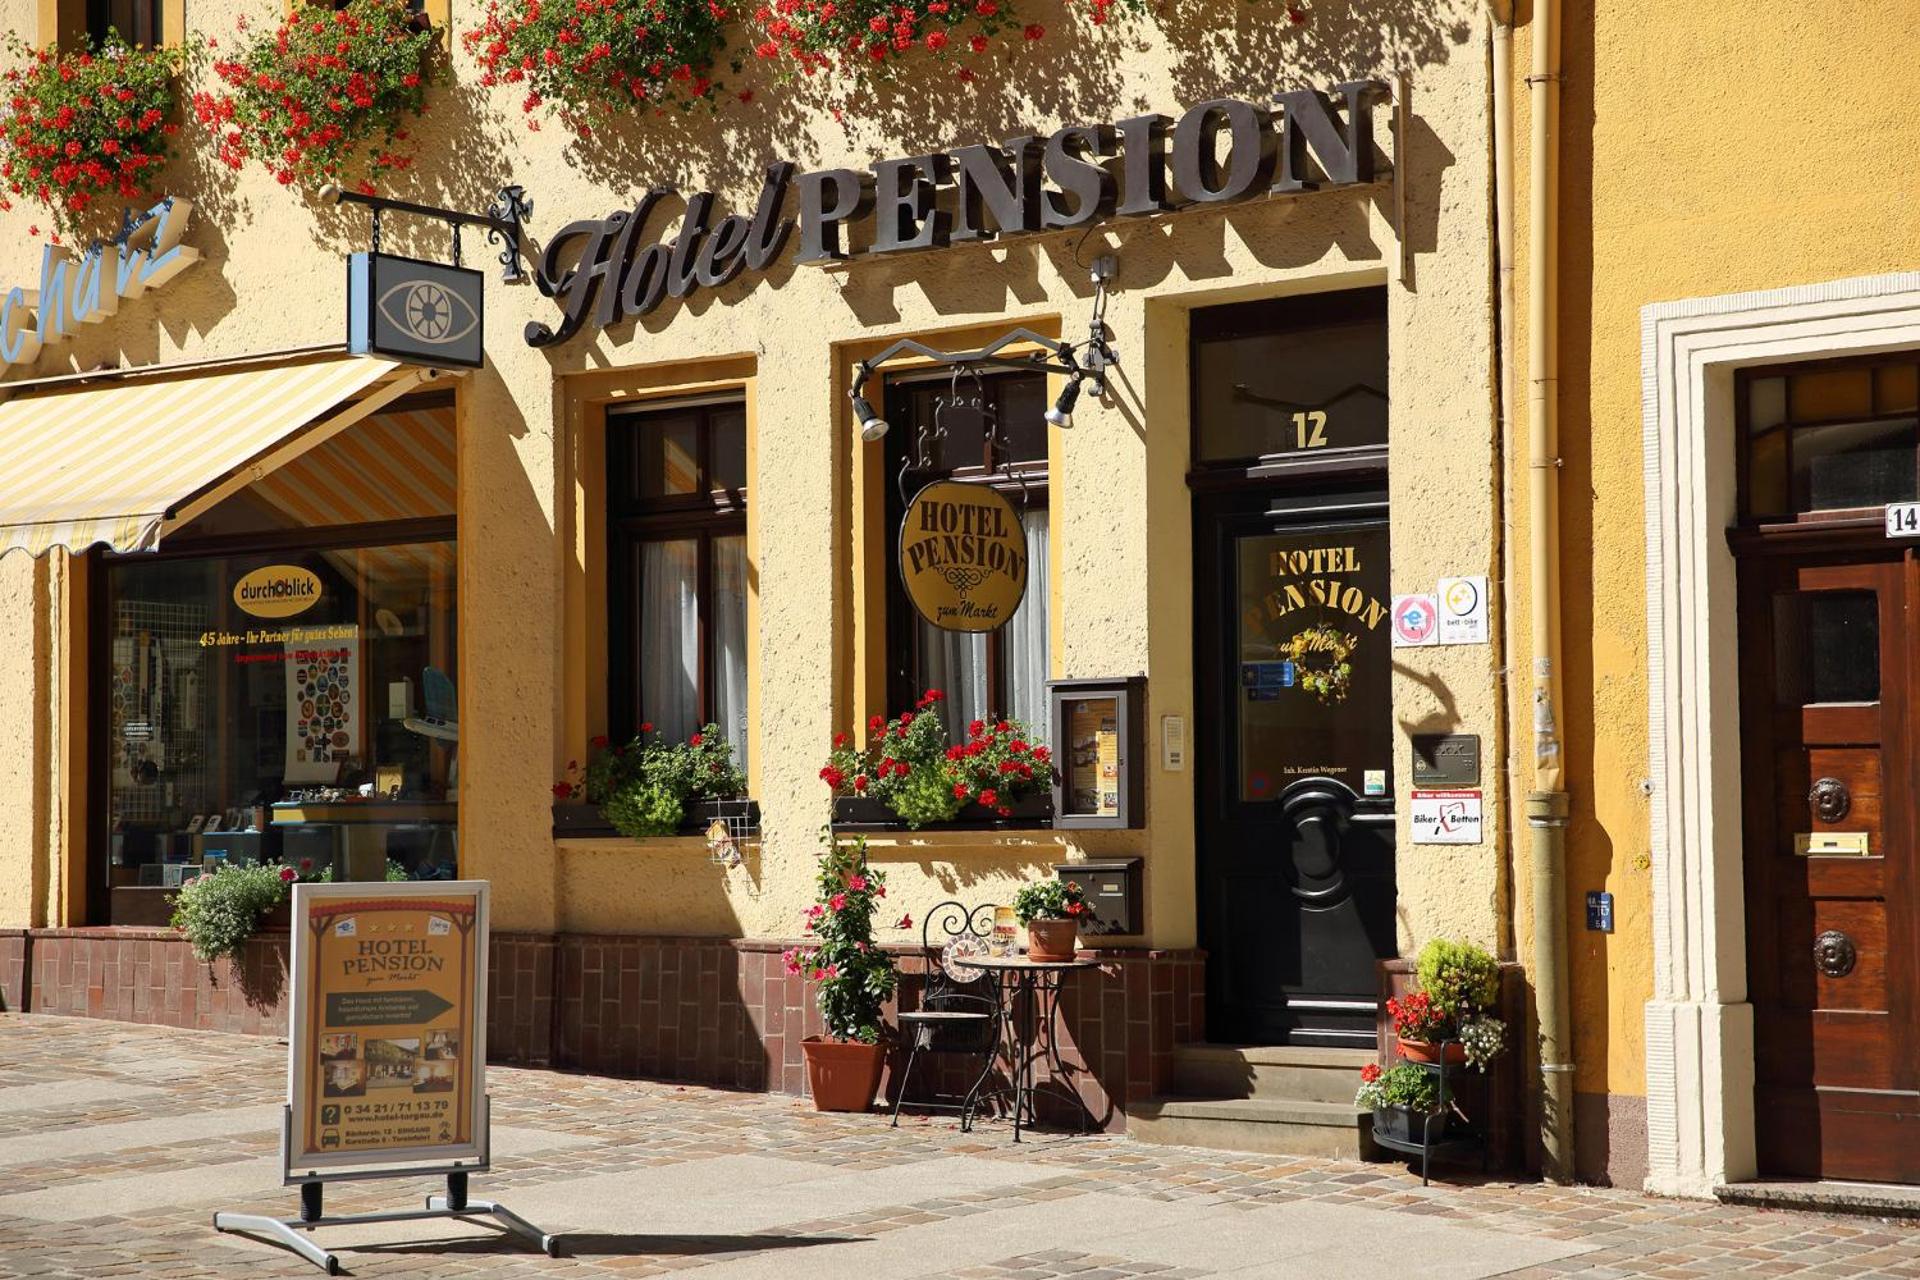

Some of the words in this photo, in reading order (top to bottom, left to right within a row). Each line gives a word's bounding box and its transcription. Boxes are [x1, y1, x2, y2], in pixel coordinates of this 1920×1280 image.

[524, 160, 797, 349] Hotel
[795, 80, 1393, 267] PENSION
[0, 196, 190, 365] chatz
[1292, 410, 1328, 449] 12
[920, 500, 1008, 538] HOTEL
[1893, 508, 1918, 531] 14
[907, 534, 1025, 582] PENSION
[1269, 546, 1361, 576] HOTEL
[937, 605, 958, 622] zum
[959, 600, 999, 619] Markt
[199, 631, 216, 647] 45
[217, 632, 240, 646] Jahre
[246, 631, 259, 644] Ihr
[260, 630, 290, 643] Partner
[291, 628, 304, 645] für
[1413, 814, 1438, 823] Biker
[358, 939, 433, 955] HOTEL
[343, 955, 444, 975] PENSION
[344, 1105, 353, 1114] 0
[355, 1104, 370, 1114] 34
[374, 1103, 387, 1113] 21
[397, 1102, 411, 1112] 71
[417, 1101, 431, 1111] 13
[434, 1100, 449, 1110] 79
[348, 1111, 444, 1123] www.hotel-torgau.de
